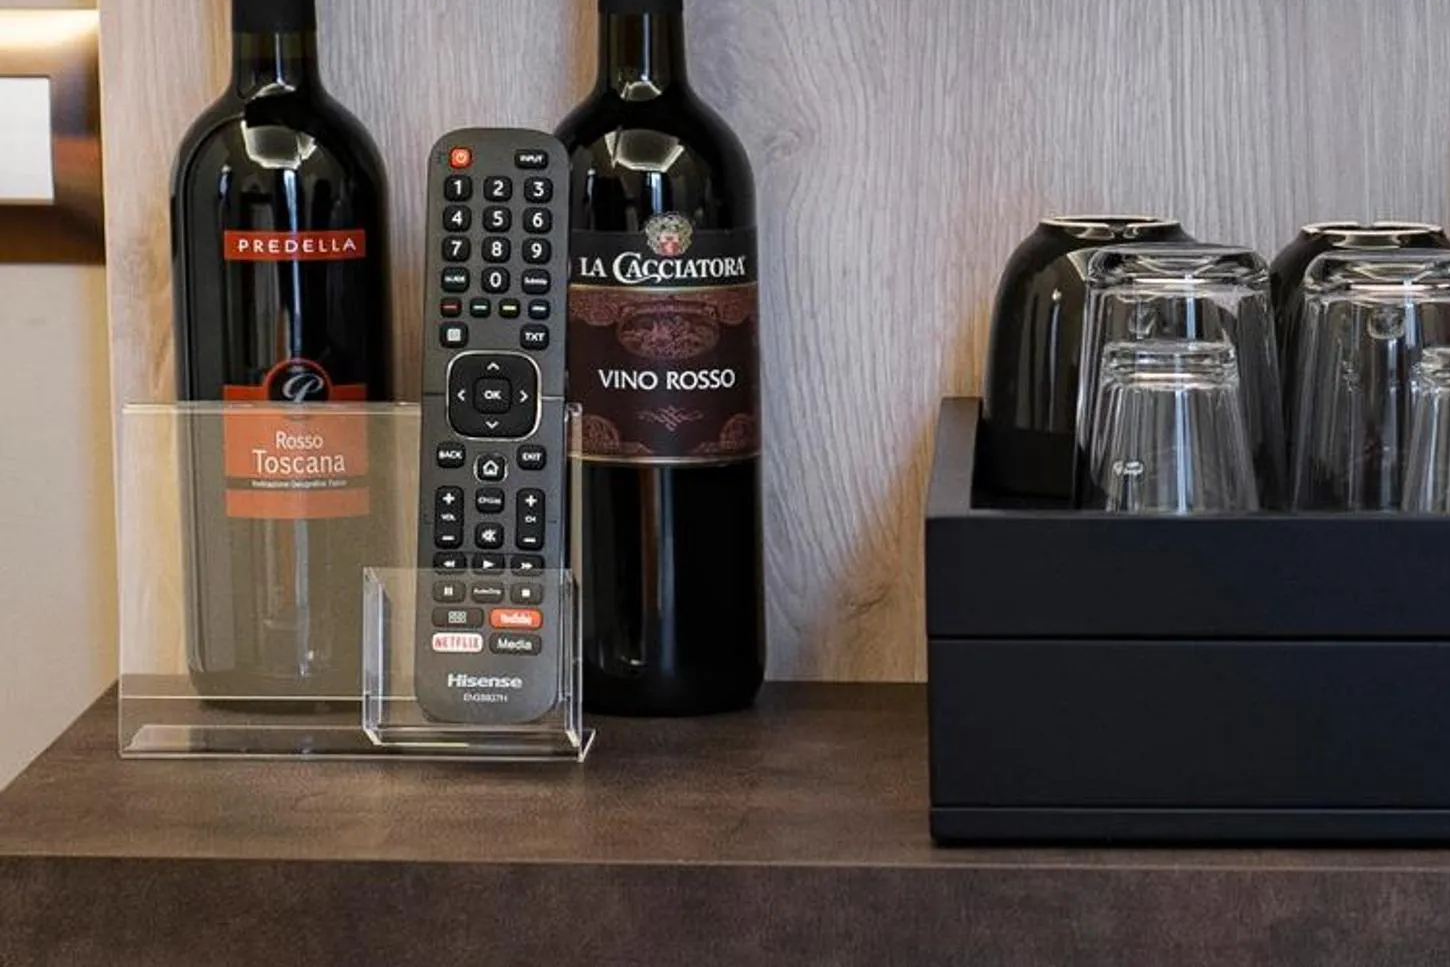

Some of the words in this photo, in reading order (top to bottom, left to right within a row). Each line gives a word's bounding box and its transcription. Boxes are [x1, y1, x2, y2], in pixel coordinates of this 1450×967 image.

[453, 180, 462, 195] 1
[493, 180, 504, 196] 2
[533, 181, 544, 197] 3
[452, 210, 463, 226] 4
[492, 210, 503, 226] 5
[532, 212, 543, 227] 6
[237, 237, 357, 254] PREDELLA
[451, 240, 462, 256] 7
[491, 241, 502, 257] 8
[531, 242, 542, 258] 9
[579, 256, 608, 278] LA
[489, 272, 501, 288] 0
[524, 332, 545, 342] TXT
[598, 369, 658, 391] VINO
[666, 368, 736, 391] ROSSO
[483, 389, 502, 400] OK
[275, 430, 324, 450] Rosso
[252, 449, 346, 475] Toscana
[438, 450, 463, 460] BACK
[521, 452, 542, 461] EXIT
[434, 637, 480, 649] NETFLIX
[497, 637, 533, 650] Media
[447, 673, 523, 688] Hisense
